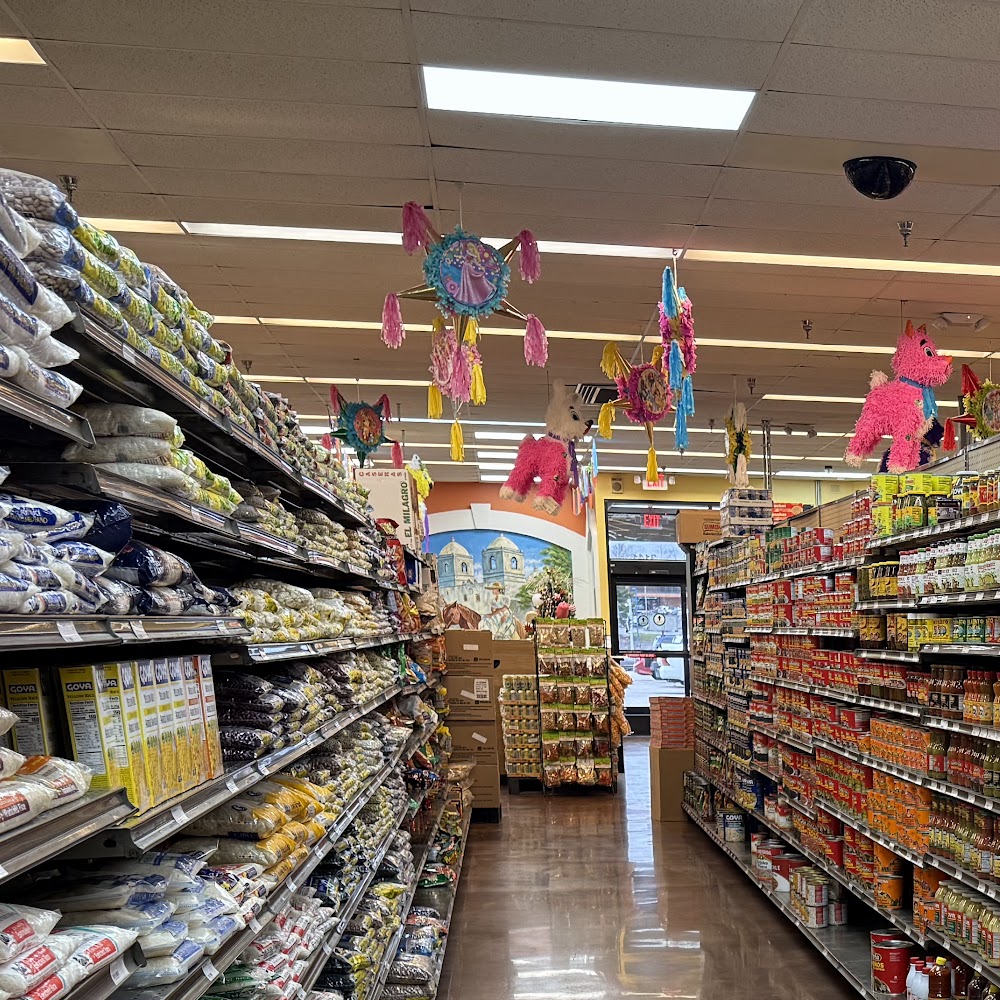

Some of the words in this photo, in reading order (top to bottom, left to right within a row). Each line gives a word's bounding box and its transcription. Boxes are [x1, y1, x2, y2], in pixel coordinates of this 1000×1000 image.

[401, 482, 412, 524] MILAGRO
[644, 514, 661, 528] EXIT
[405, 528, 412, 538] EL
[67, 683, 93, 691] GOYA
